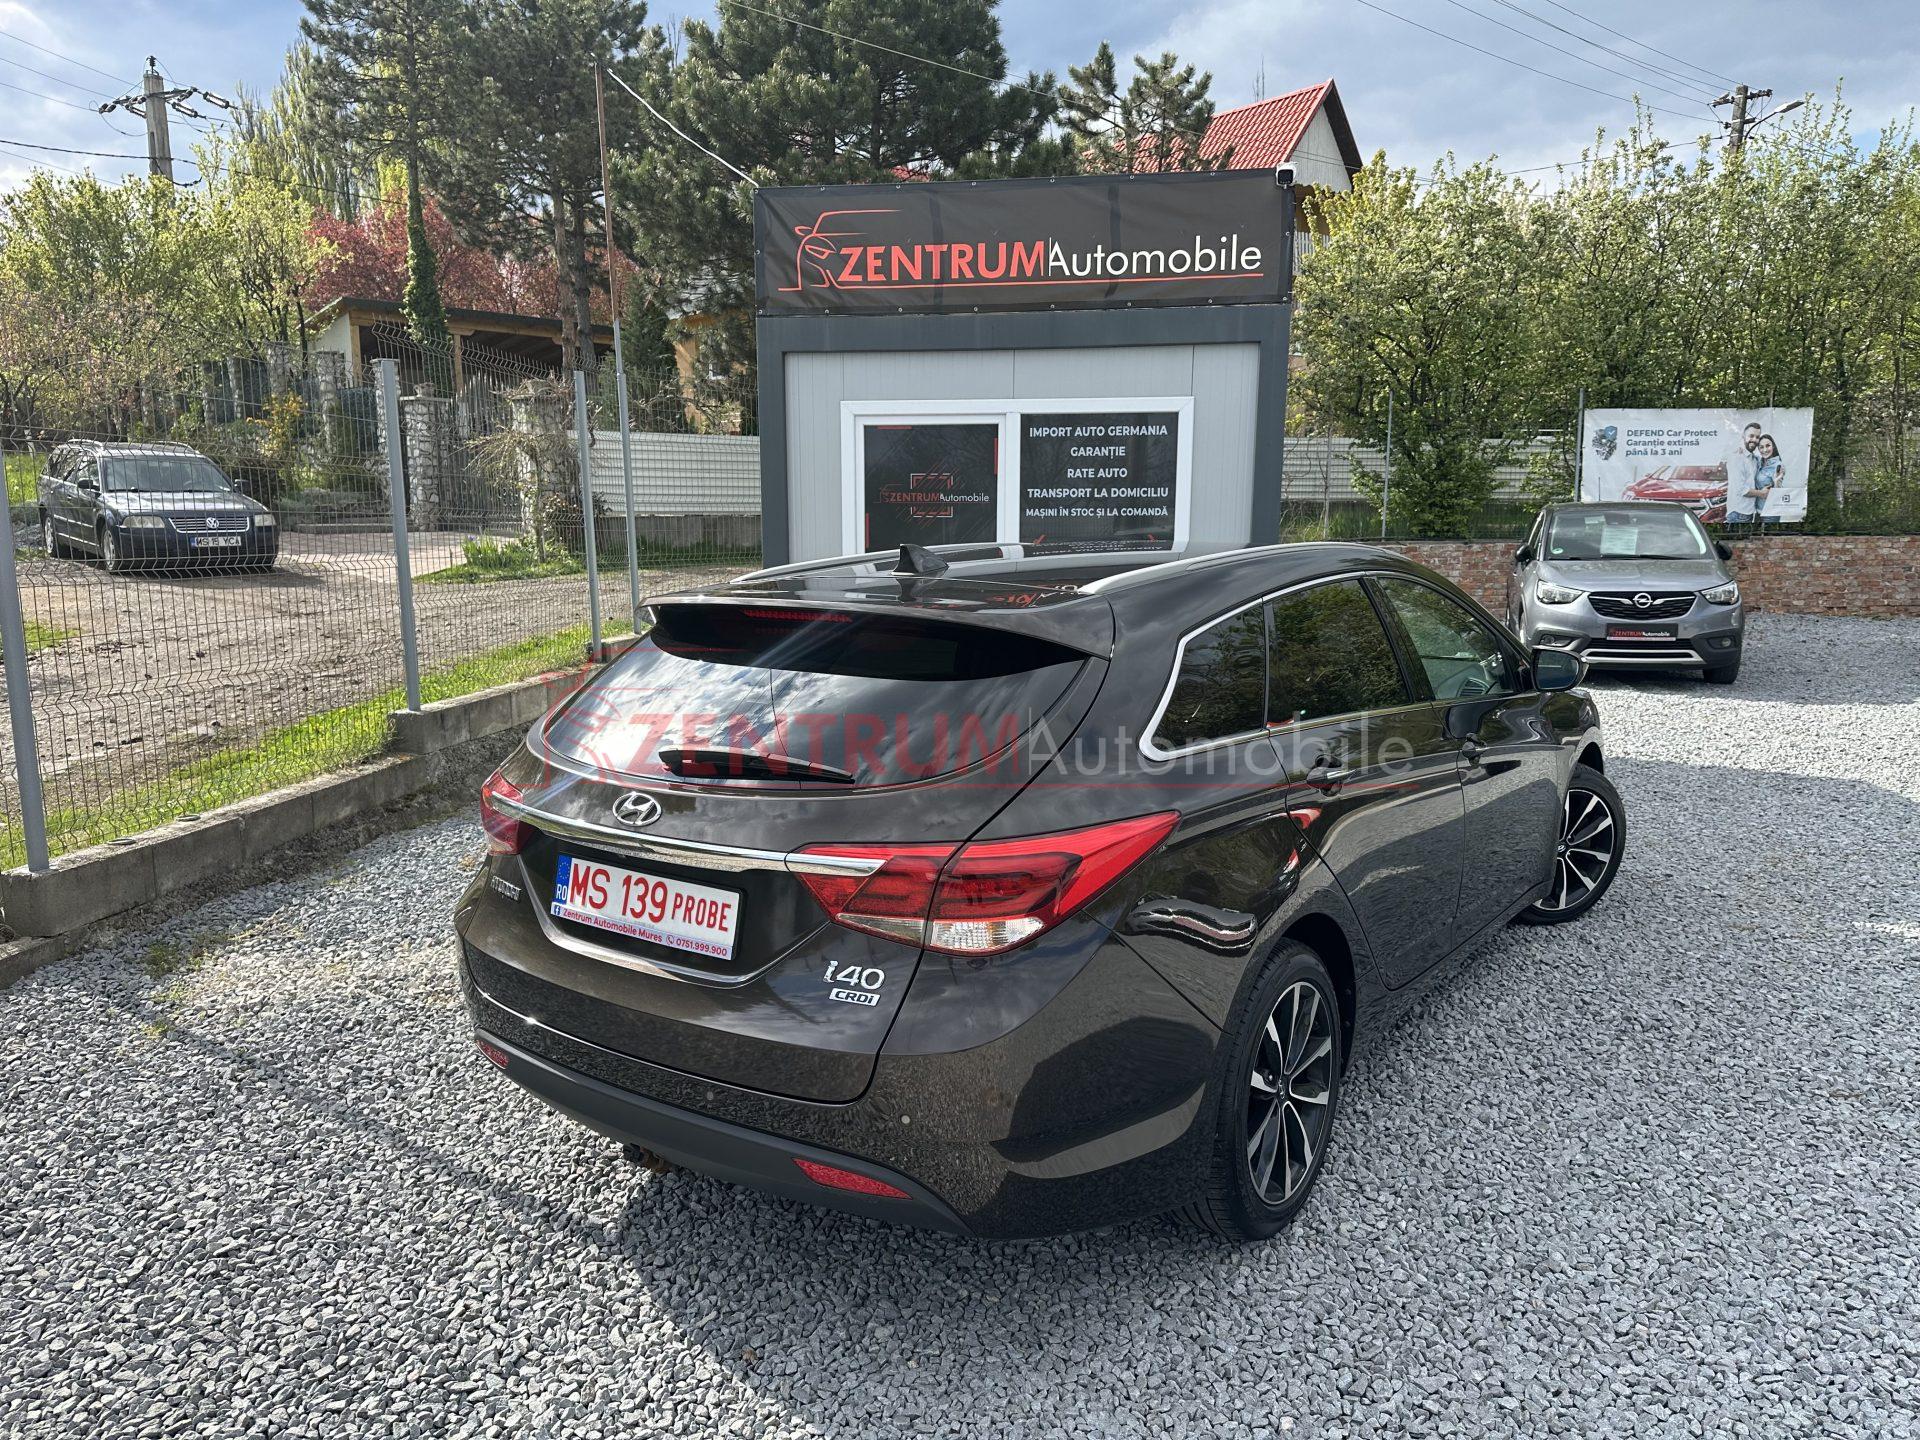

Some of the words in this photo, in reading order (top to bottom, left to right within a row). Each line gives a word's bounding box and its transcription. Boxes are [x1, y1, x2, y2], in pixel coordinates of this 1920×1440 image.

[838, 240, 1044, 282] ZENTRUM
[1029, 426, 1072, 438] IMPORT
[1074, 426, 1105, 437] AUTO
[1107, 425, 1168, 436] GERMANIA
[1626, 429, 1665, 437] DEFEND
[1666, 429, 1682, 437] Car
[1684, 429, 1718, 437] Protect
[1070, 446, 1126, 459] GARANȚIE
[1650, 448, 1659, 456] la
[1660, 448, 1666, 456] 3
[1668, 447, 1683, 456] ani
[1067, 468, 1095, 478] RATE
[1097, 467, 1128, 478] AUTO
[890, 492, 940, 502] ZENTRUM
[1027, 488, 1092, 498] TRANSPORT
[1094, 488, 1108, 498] LA
[1110, 487, 1169, 498] DOMICILIU
[1026, 508, 1058, 519] MAȘINI
[1060, 506, 1069, 516] ÎN
[1071, 508, 1094, 516] STOC
[1107, 508, 1119, 516] LA
[1121, 506, 1168, 516] COMANDĂ
[556, 883, 568, 901] RO
[569, 863, 611, 910] MS
[621, 874, 668, 924] 139
[671, 892, 732, 932] PROBE
[563, 908, 593, 924] Zentrum
[593, 915, 638, 937] Automobile
[638, 929, 663, 943] Mures
[675, 938, 728, 957] 0751.999.900
[823, 960, 885, 990] i40
[835, 990, 875, 1004] CRDi
